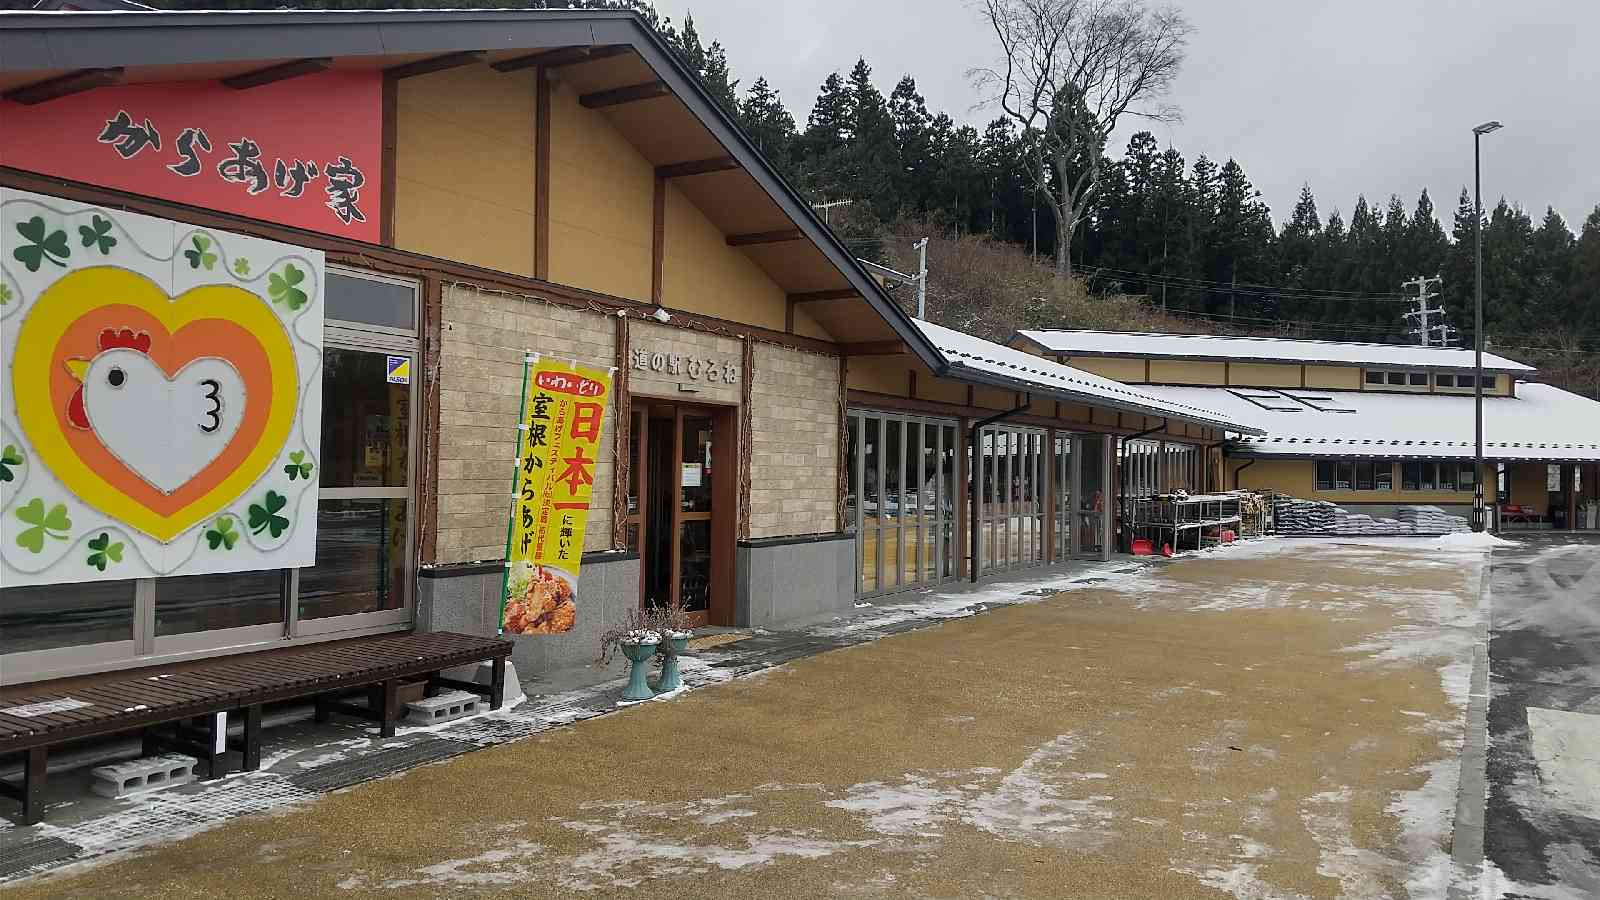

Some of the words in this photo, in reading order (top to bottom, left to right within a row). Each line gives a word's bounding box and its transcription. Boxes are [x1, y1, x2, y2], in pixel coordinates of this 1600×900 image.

[97, 111, 367, 224] からあげ家
[520, 391, 554, 555] 室根からあげ
